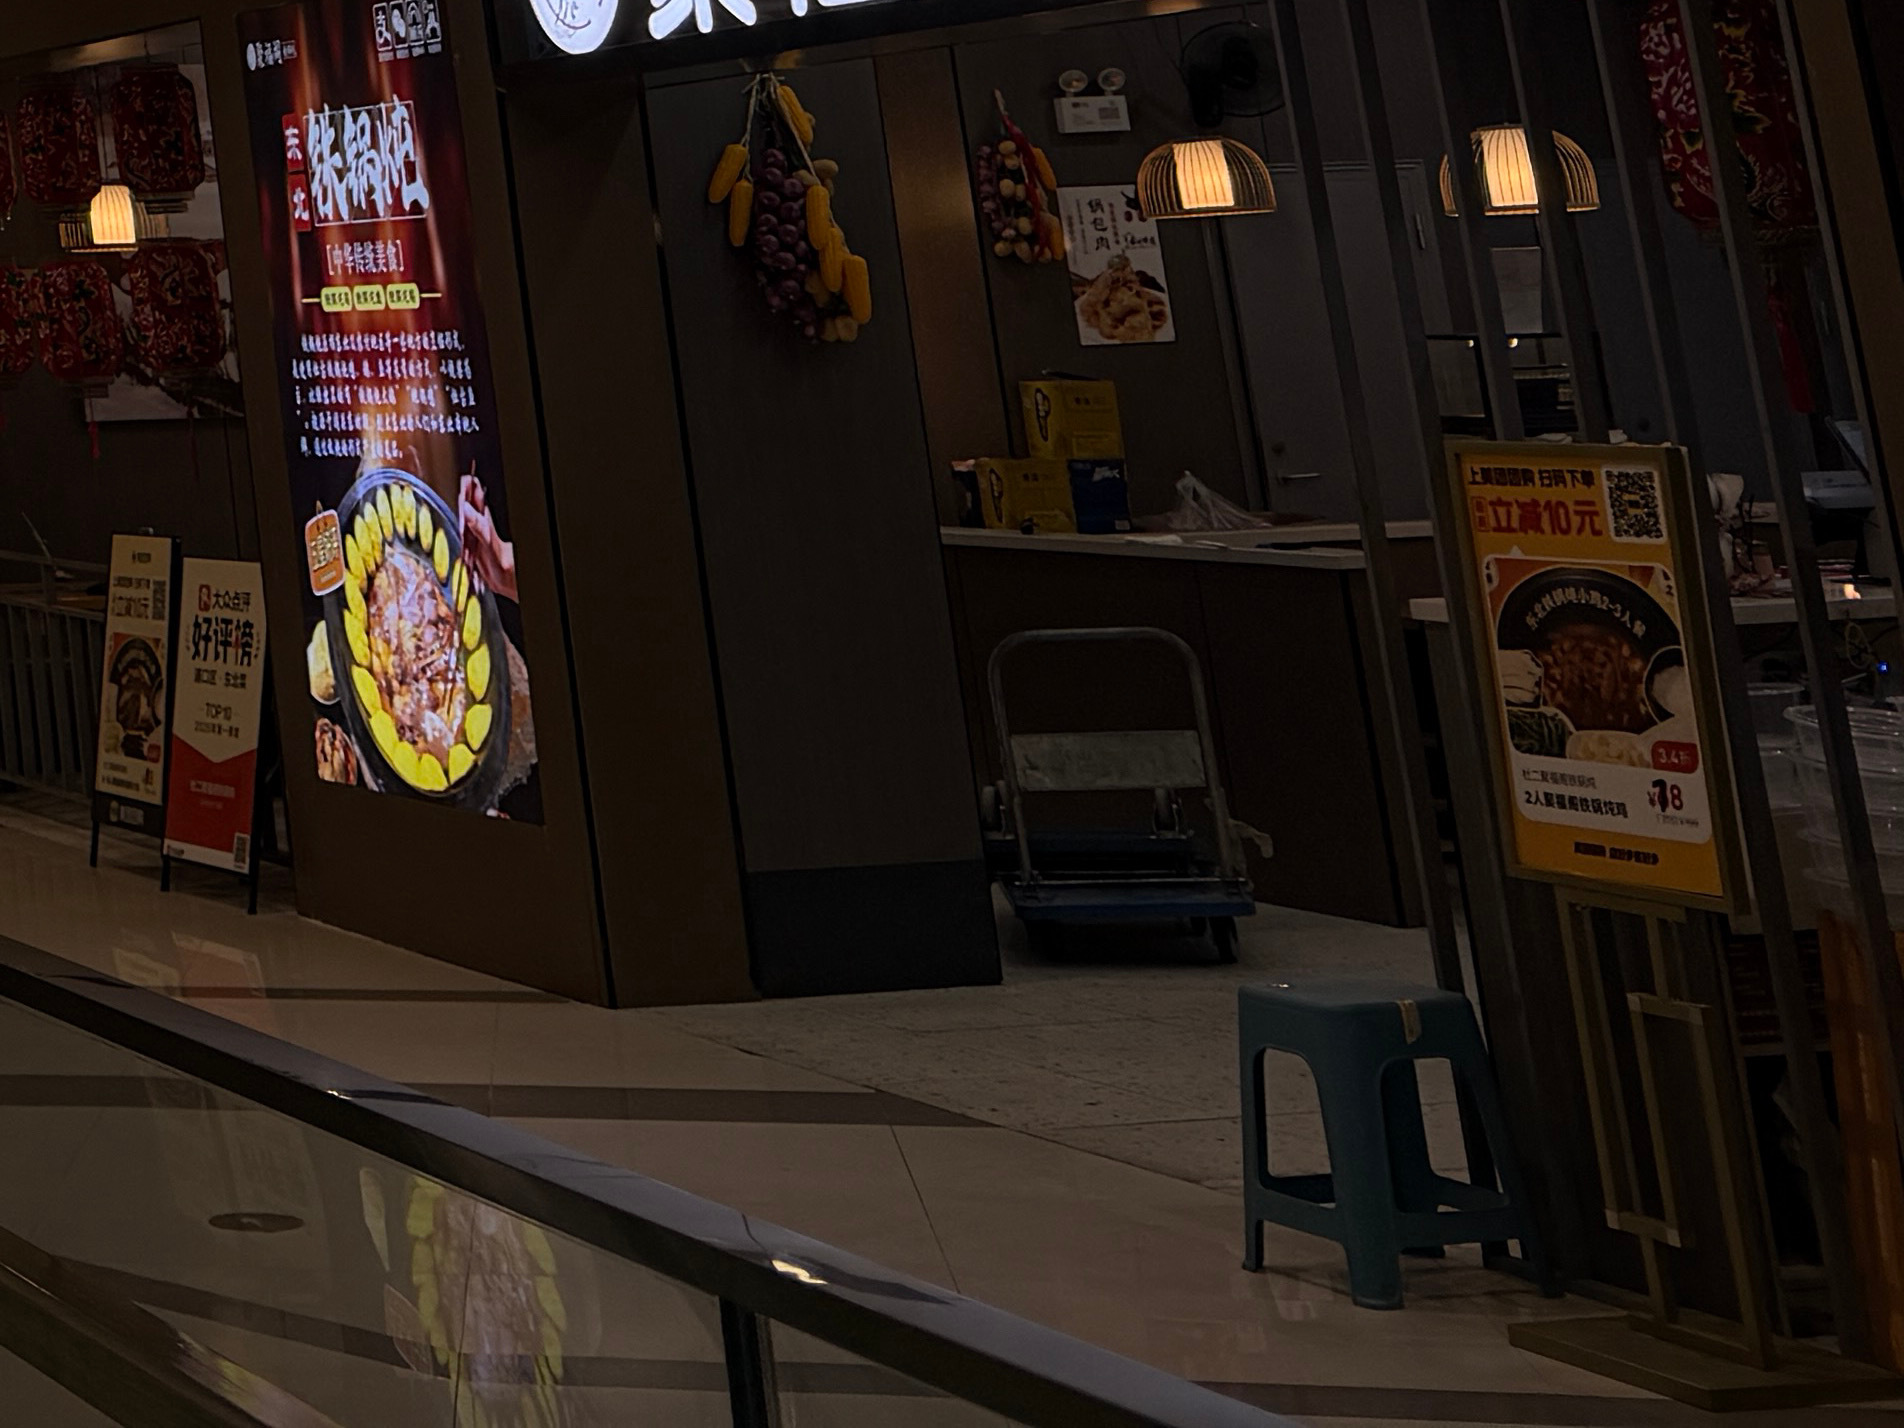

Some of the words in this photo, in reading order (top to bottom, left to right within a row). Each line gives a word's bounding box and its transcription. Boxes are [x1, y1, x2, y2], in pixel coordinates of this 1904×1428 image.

[1489, 497, 1603, 536] 立减10元
[192, 614, 254, 667] 好评榜
